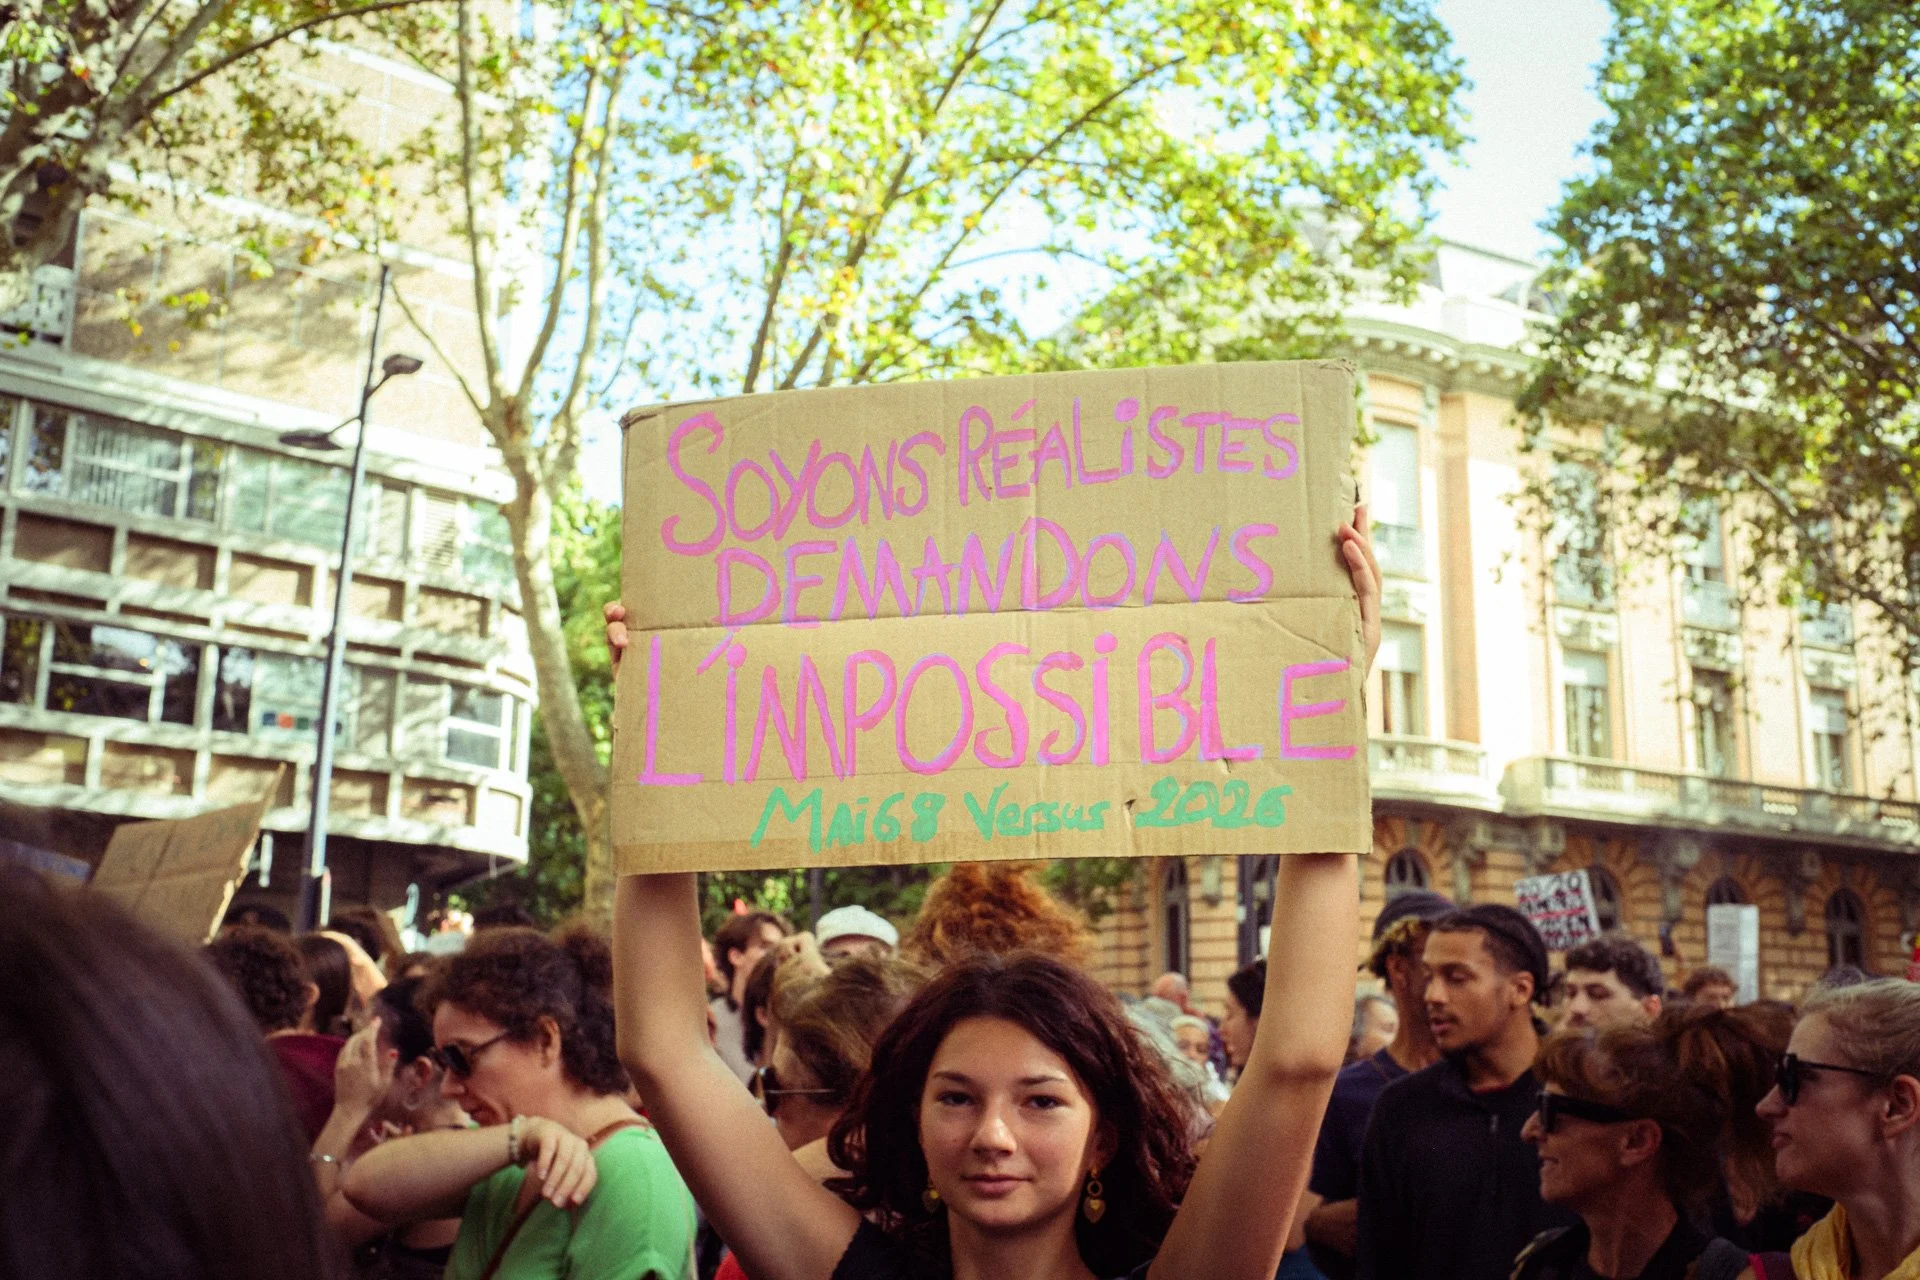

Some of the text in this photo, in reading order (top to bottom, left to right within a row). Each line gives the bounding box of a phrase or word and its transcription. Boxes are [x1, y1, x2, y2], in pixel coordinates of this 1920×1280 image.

[661, 412, 946, 556] SOYONS
[715, 517, 1279, 627] DEMANDONS
[963, 781, 1110, 841] Versus
